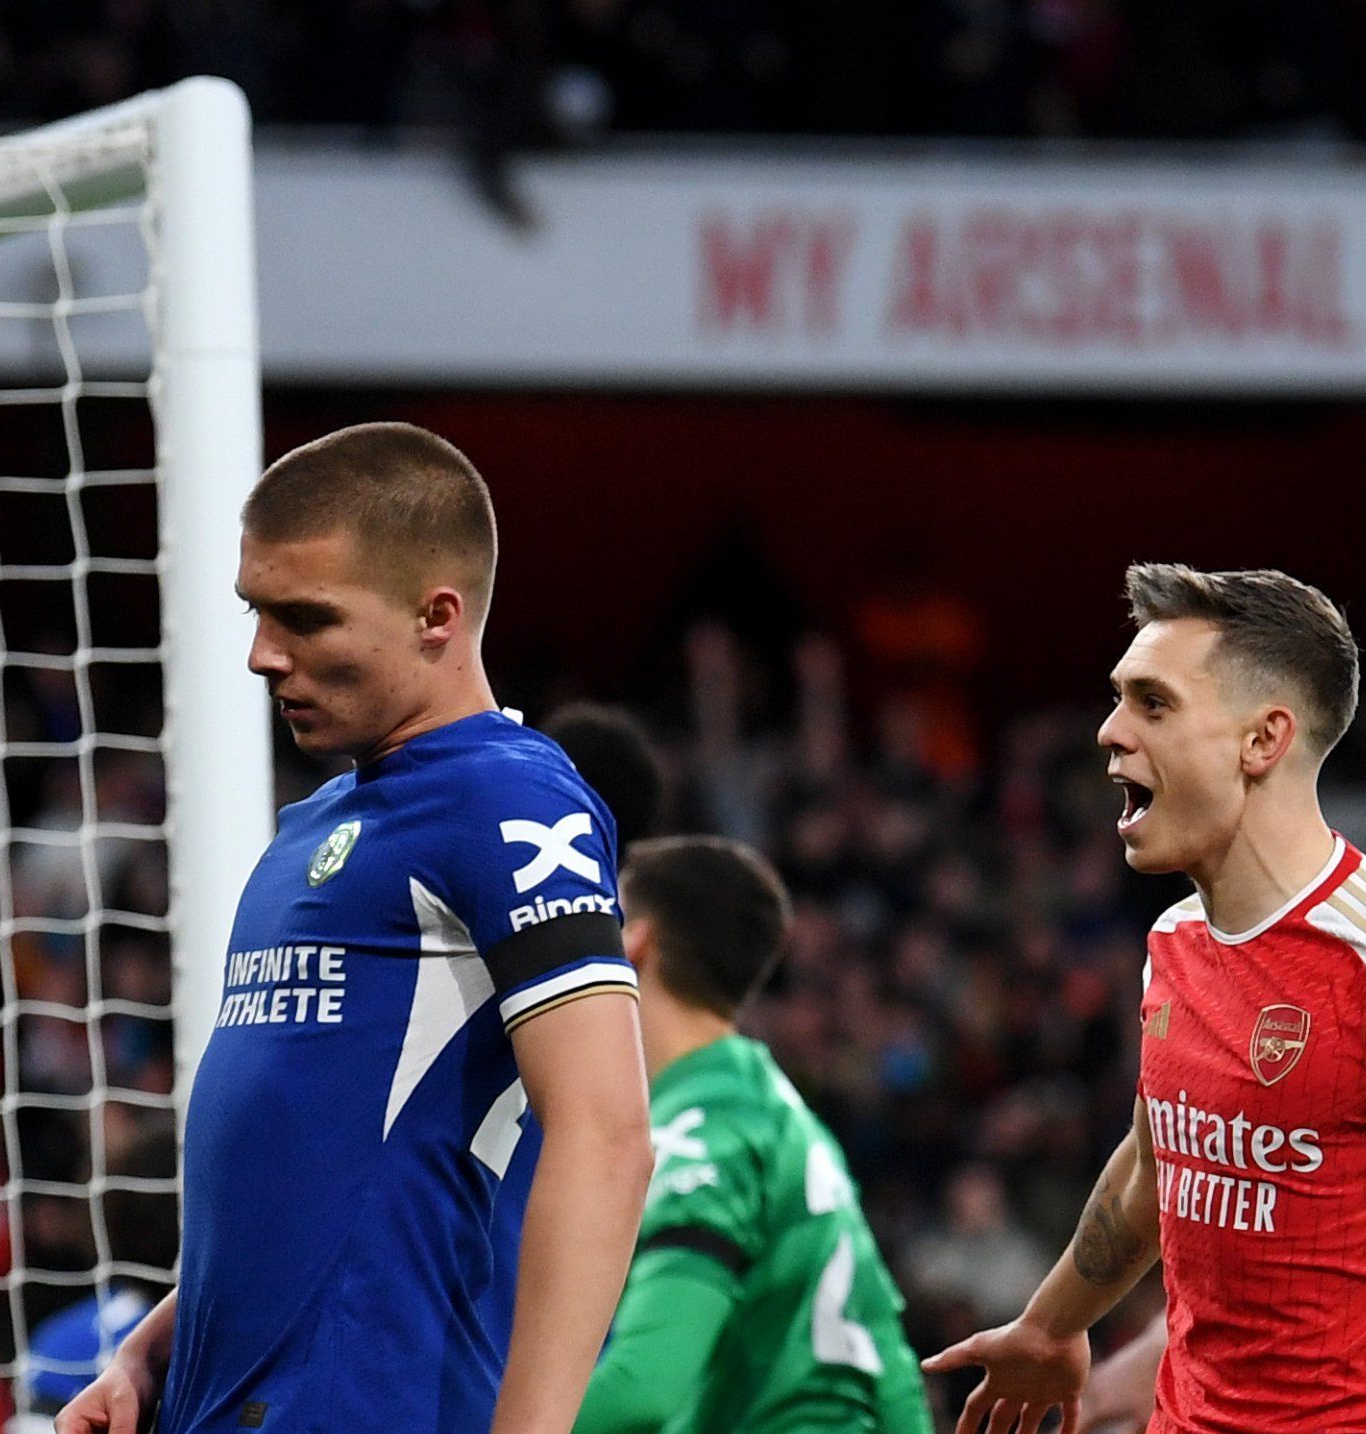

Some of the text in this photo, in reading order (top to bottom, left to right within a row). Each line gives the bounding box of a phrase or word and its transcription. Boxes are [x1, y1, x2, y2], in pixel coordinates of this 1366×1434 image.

[693, 207, 859, 337] MY
[885, 207, 1359, 345] ARSENAL
[227, 946, 346, 987] INFINITE
[215, 988, 345, 1028] ATHLETE
[1147, 1089, 1323, 1173] mirates
[1177, 1167, 1276, 1232] BETTER
